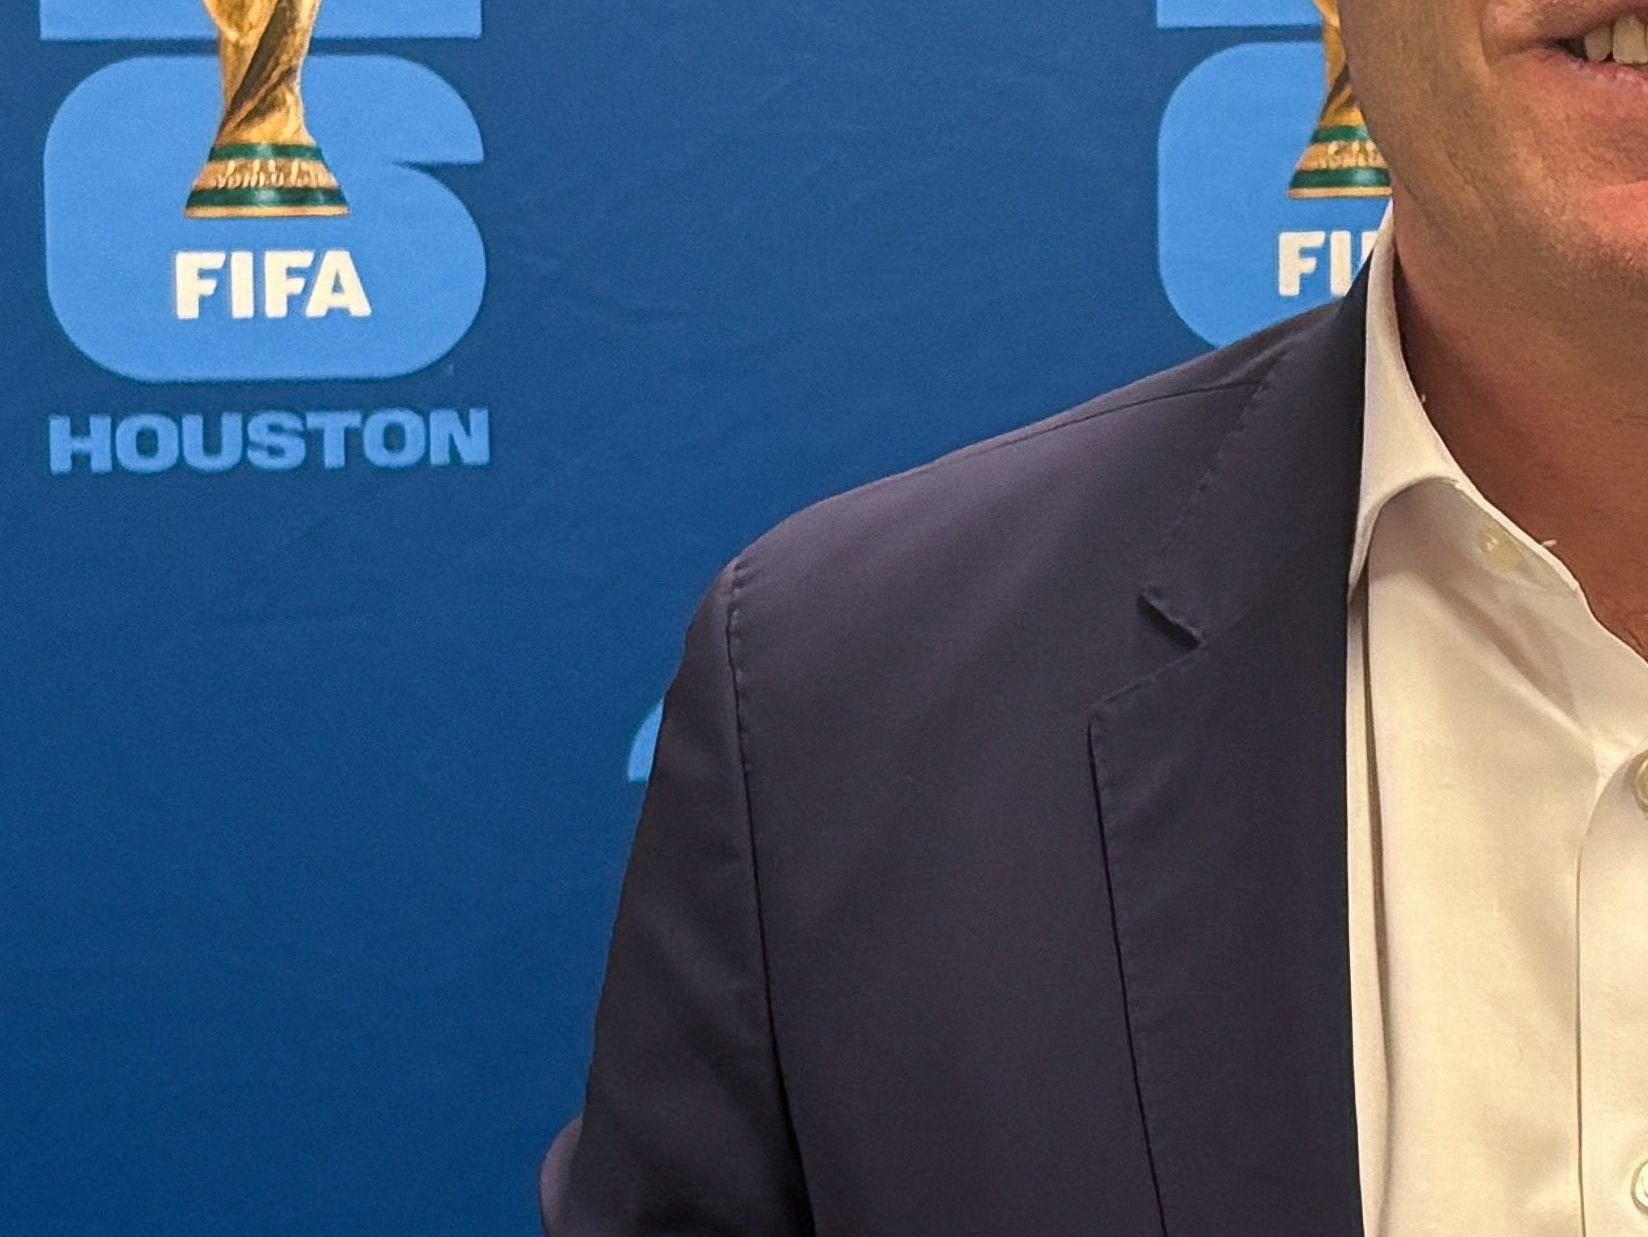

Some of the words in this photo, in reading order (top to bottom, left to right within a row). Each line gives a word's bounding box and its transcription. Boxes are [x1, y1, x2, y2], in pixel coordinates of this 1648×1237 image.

[174, 250, 371, 320] FIFA
[1278, 230, 1378, 298] FI
[48, 408, 490, 475] HOUSTON
